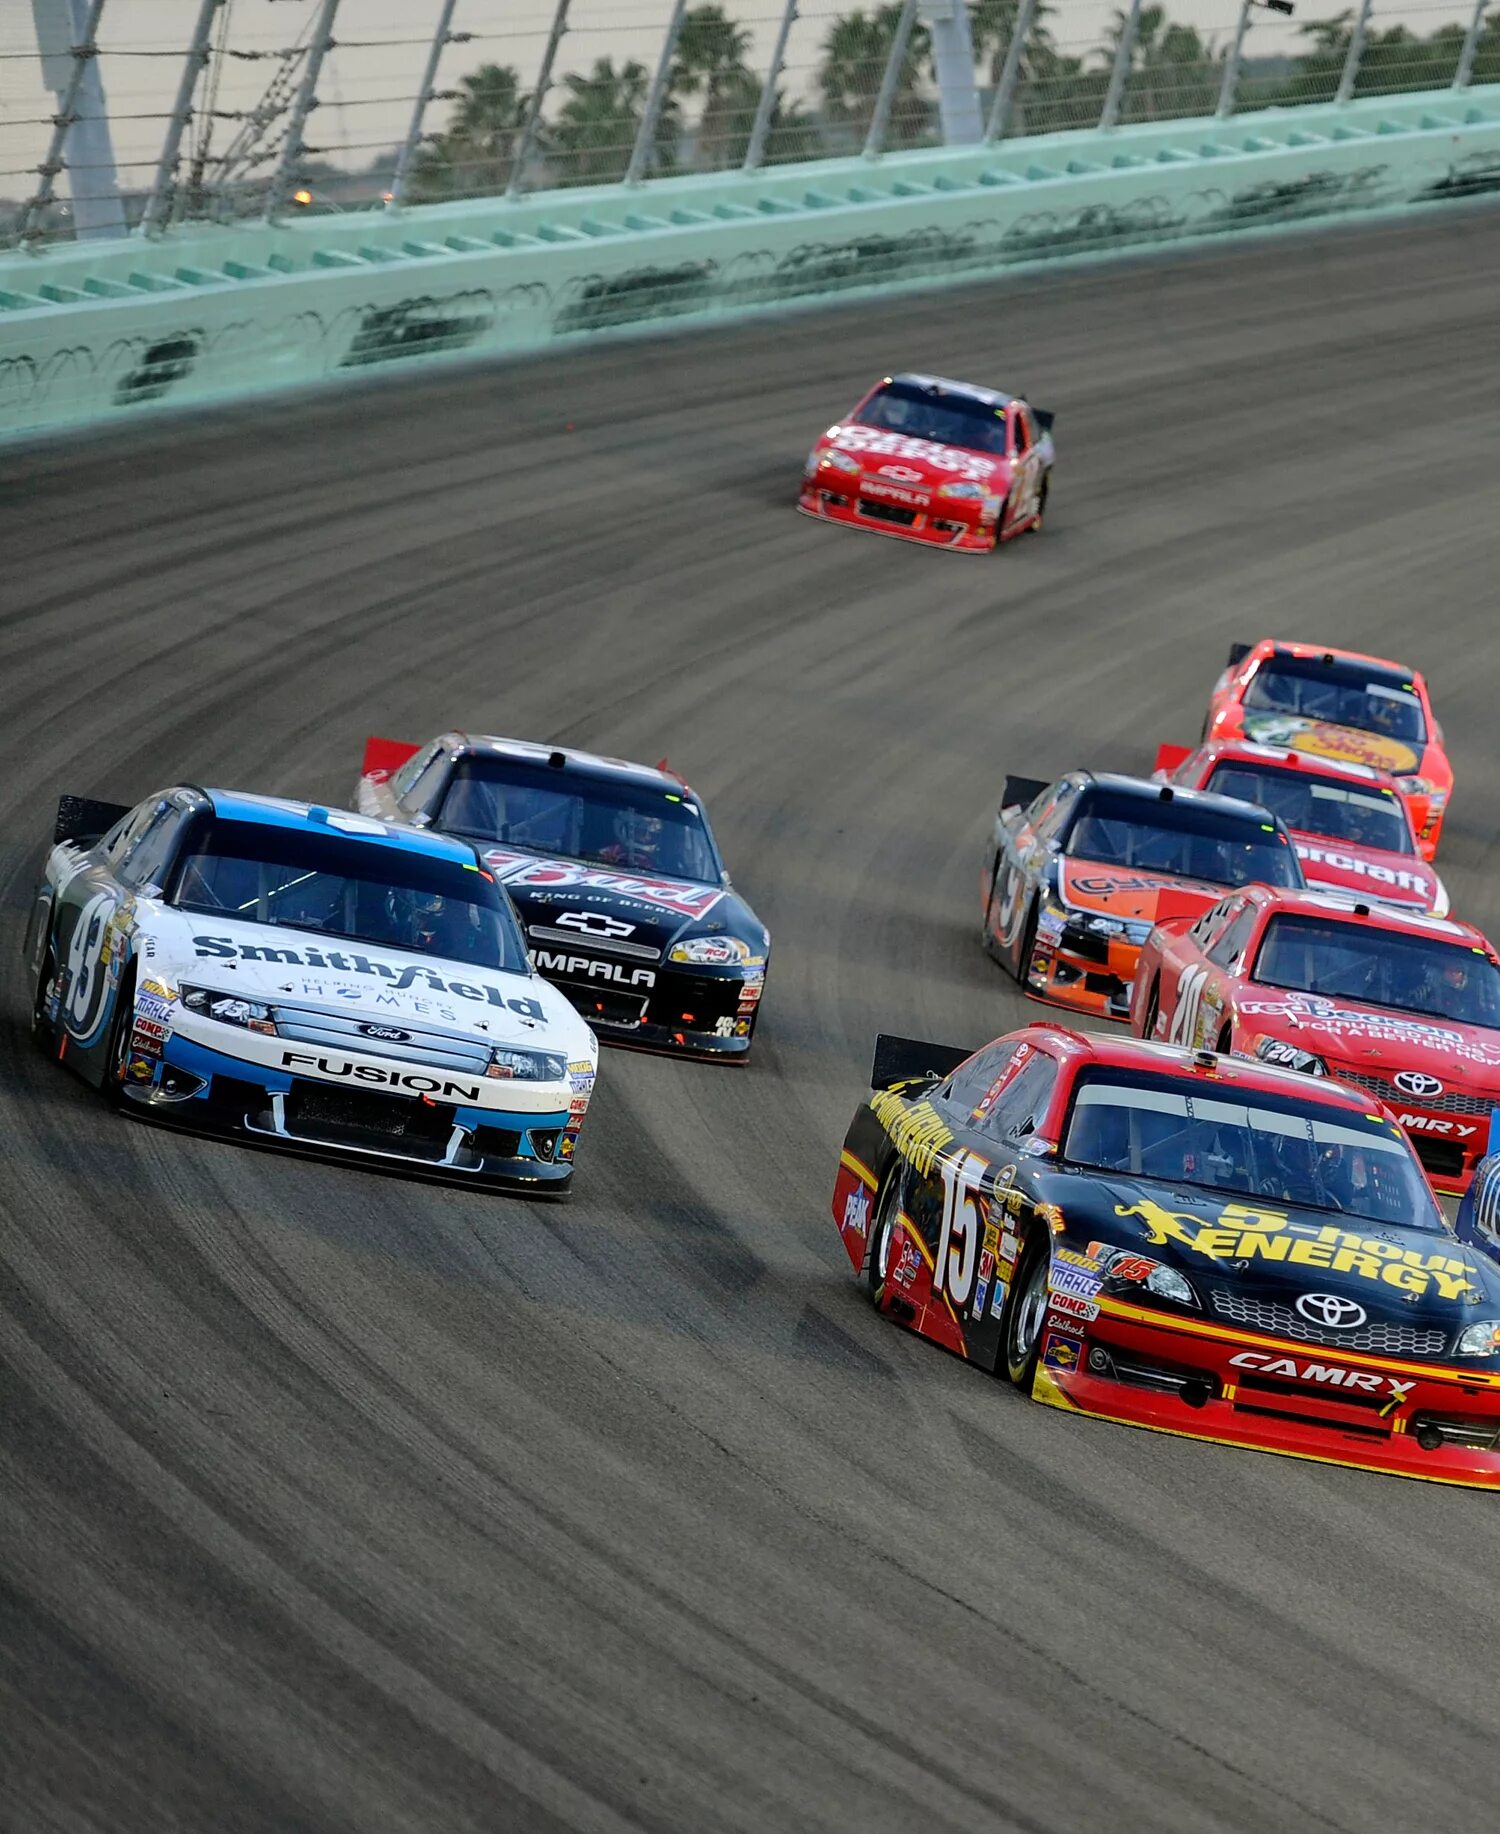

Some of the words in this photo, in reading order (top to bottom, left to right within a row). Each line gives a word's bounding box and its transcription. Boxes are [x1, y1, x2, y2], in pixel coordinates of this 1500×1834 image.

[1296, 845, 1430, 898] rcraft
[193, 935, 548, 1024] Smithfield
[135, 997, 176, 1022] MAHLE
[210, 999, 251, 1019] 43
[135, 1017, 162, 1035] COMP
[367, 1024, 402, 1040] Ford
[1298, 1021, 1342, 1036] FOR
[1349, 1028, 1364, 1038] A
[1366, 1030, 1452, 1054] BETTER
[1266, 1042, 1298, 1063] 20
[281, 1051, 480, 1101] FUSION
[1399, 1113, 1480, 1137] MRY
[933, 1147, 991, 1304] 15
[1217, 1203, 1478, 1275] 5-hour
[1055, 1248, 1105, 1272] MOOG
[1110, 1256, 1158, 1281] 15
[1197, 1227, 1477, 1301] ENERGY
[1053, 1269, 1103, 1297] MAHLE
[1052, 1293, 1088, 1314] COMP
[1048, 1314, 1086, 1338] Edelbrock
[1228, 1351, 1418, 1397] CAMRY
